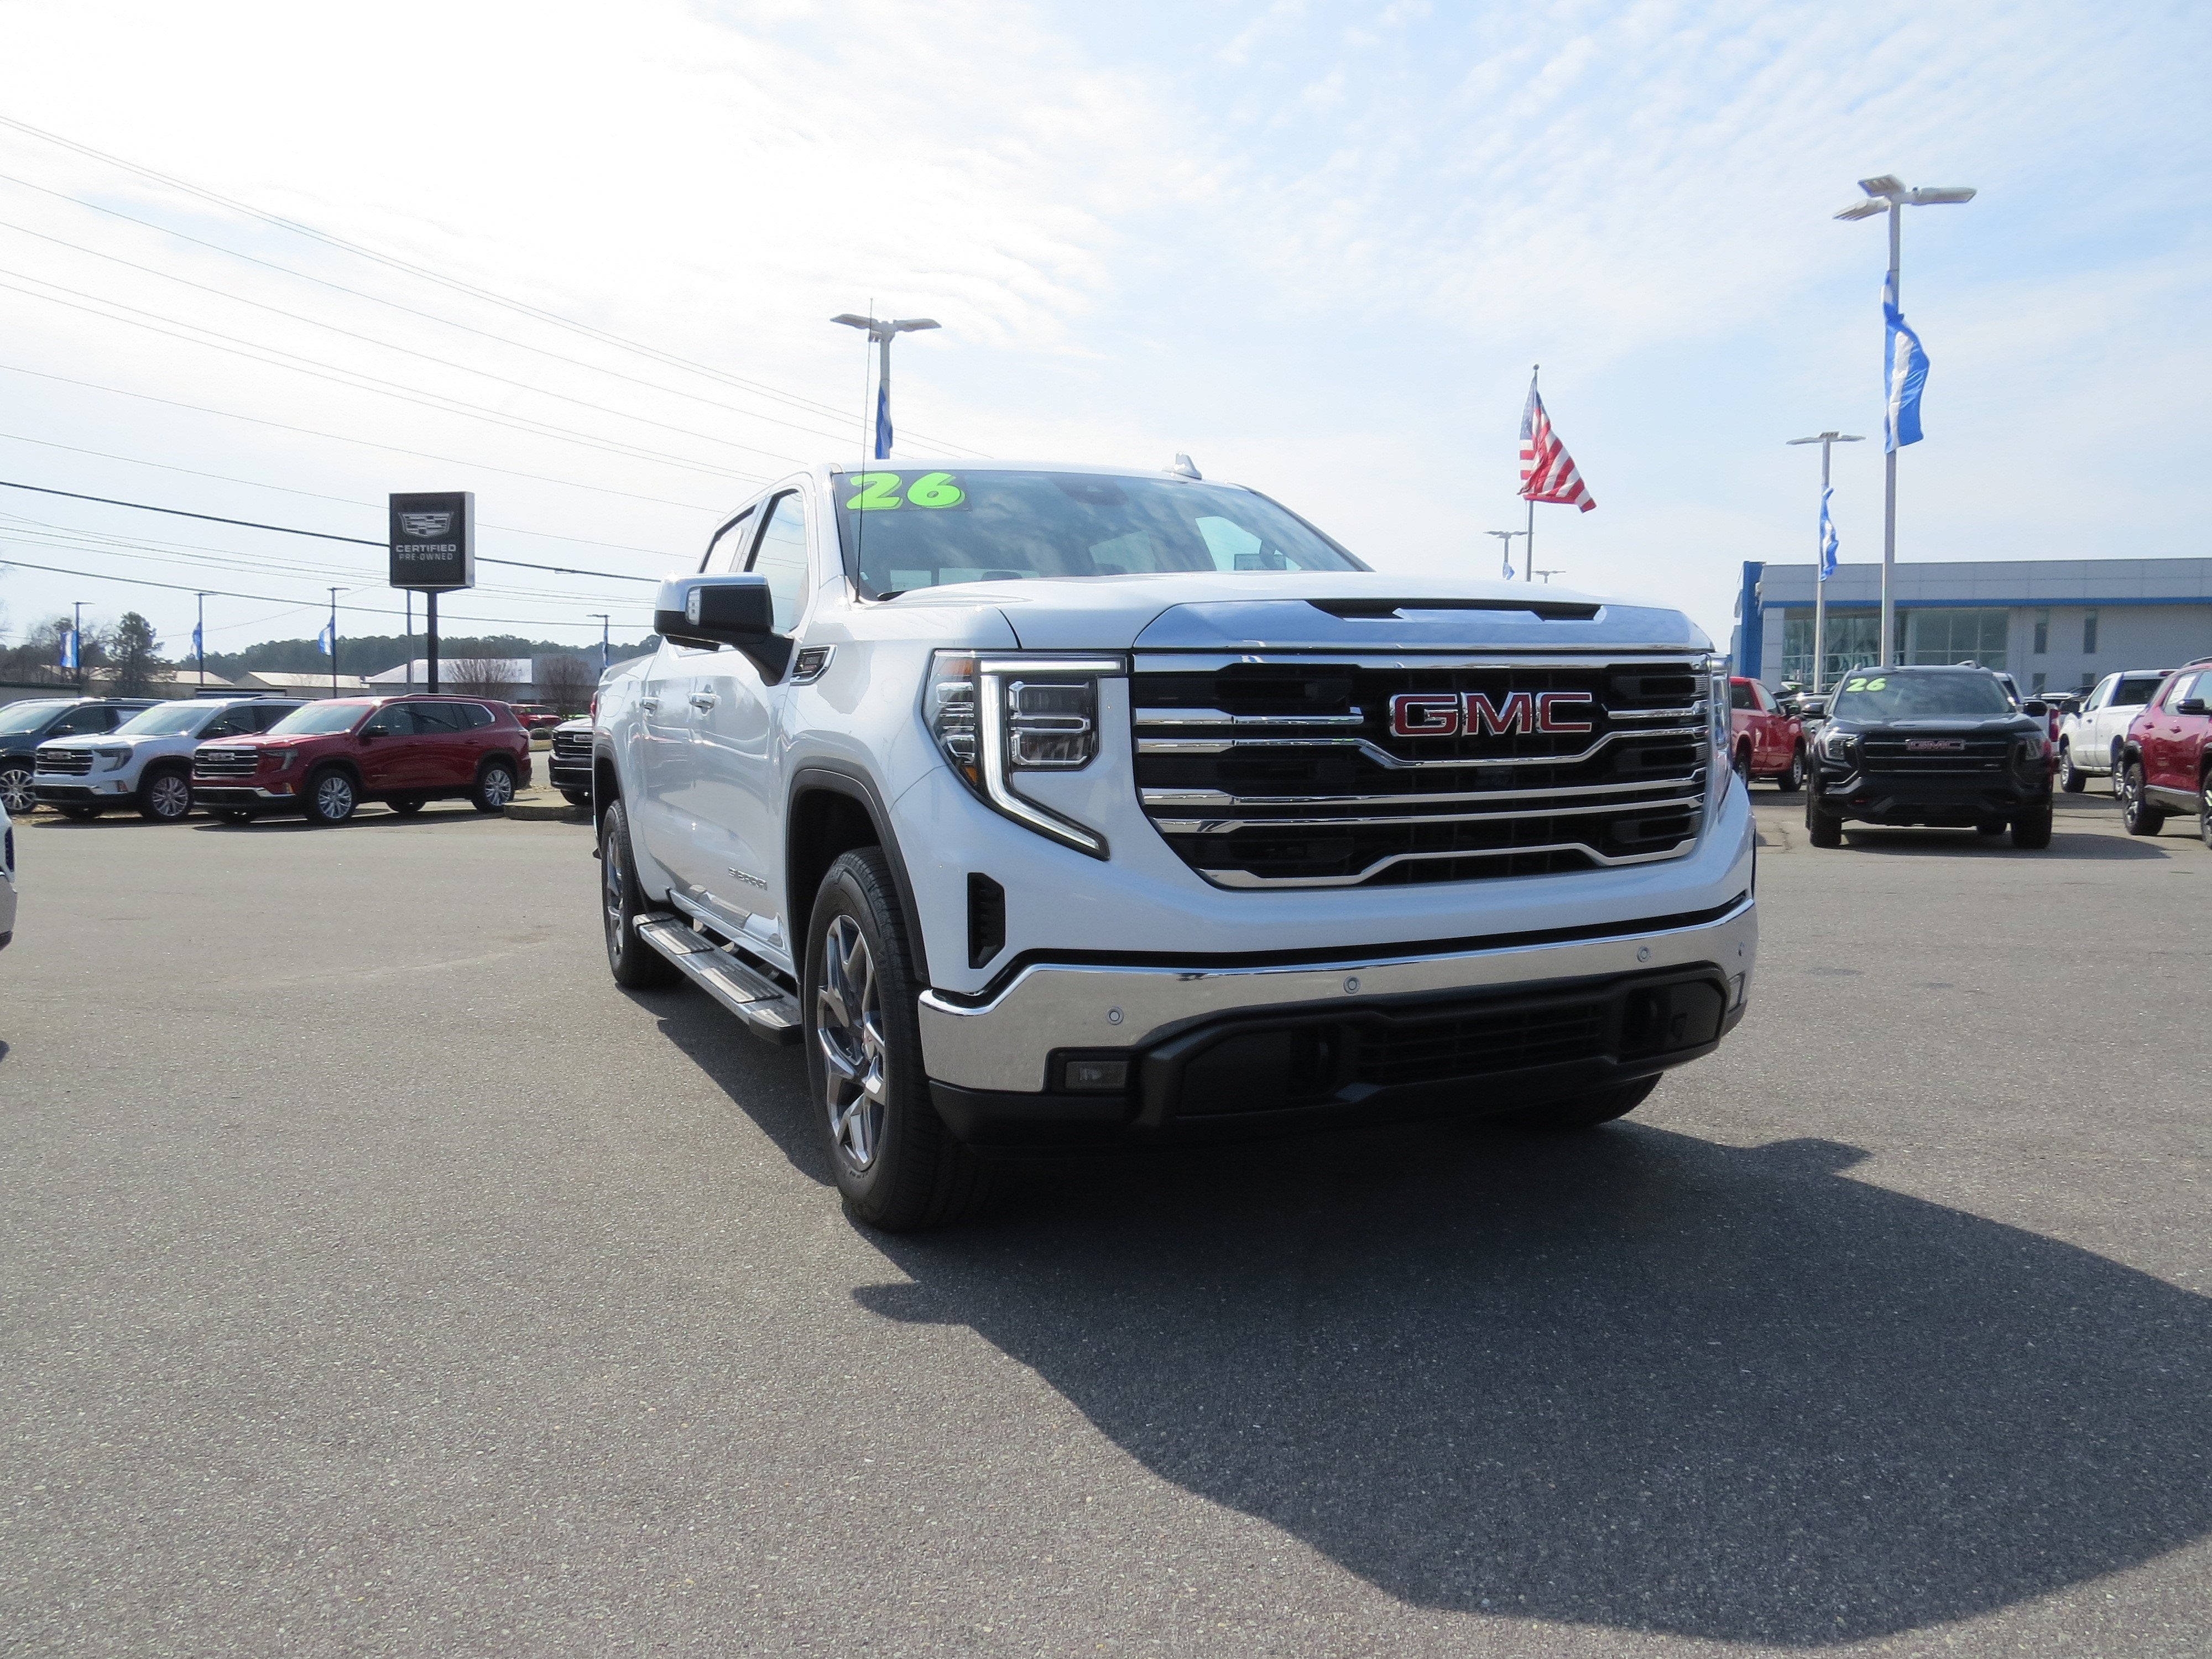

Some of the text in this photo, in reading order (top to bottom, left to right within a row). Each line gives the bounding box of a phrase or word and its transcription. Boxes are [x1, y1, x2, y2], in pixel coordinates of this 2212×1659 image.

[846, 472, 966, 510] 26
[396, 544, 457, 552] CERTIFIED
[1845, 677, 1887, 692] 26
[1389, 691, 1593, 737] GMC
